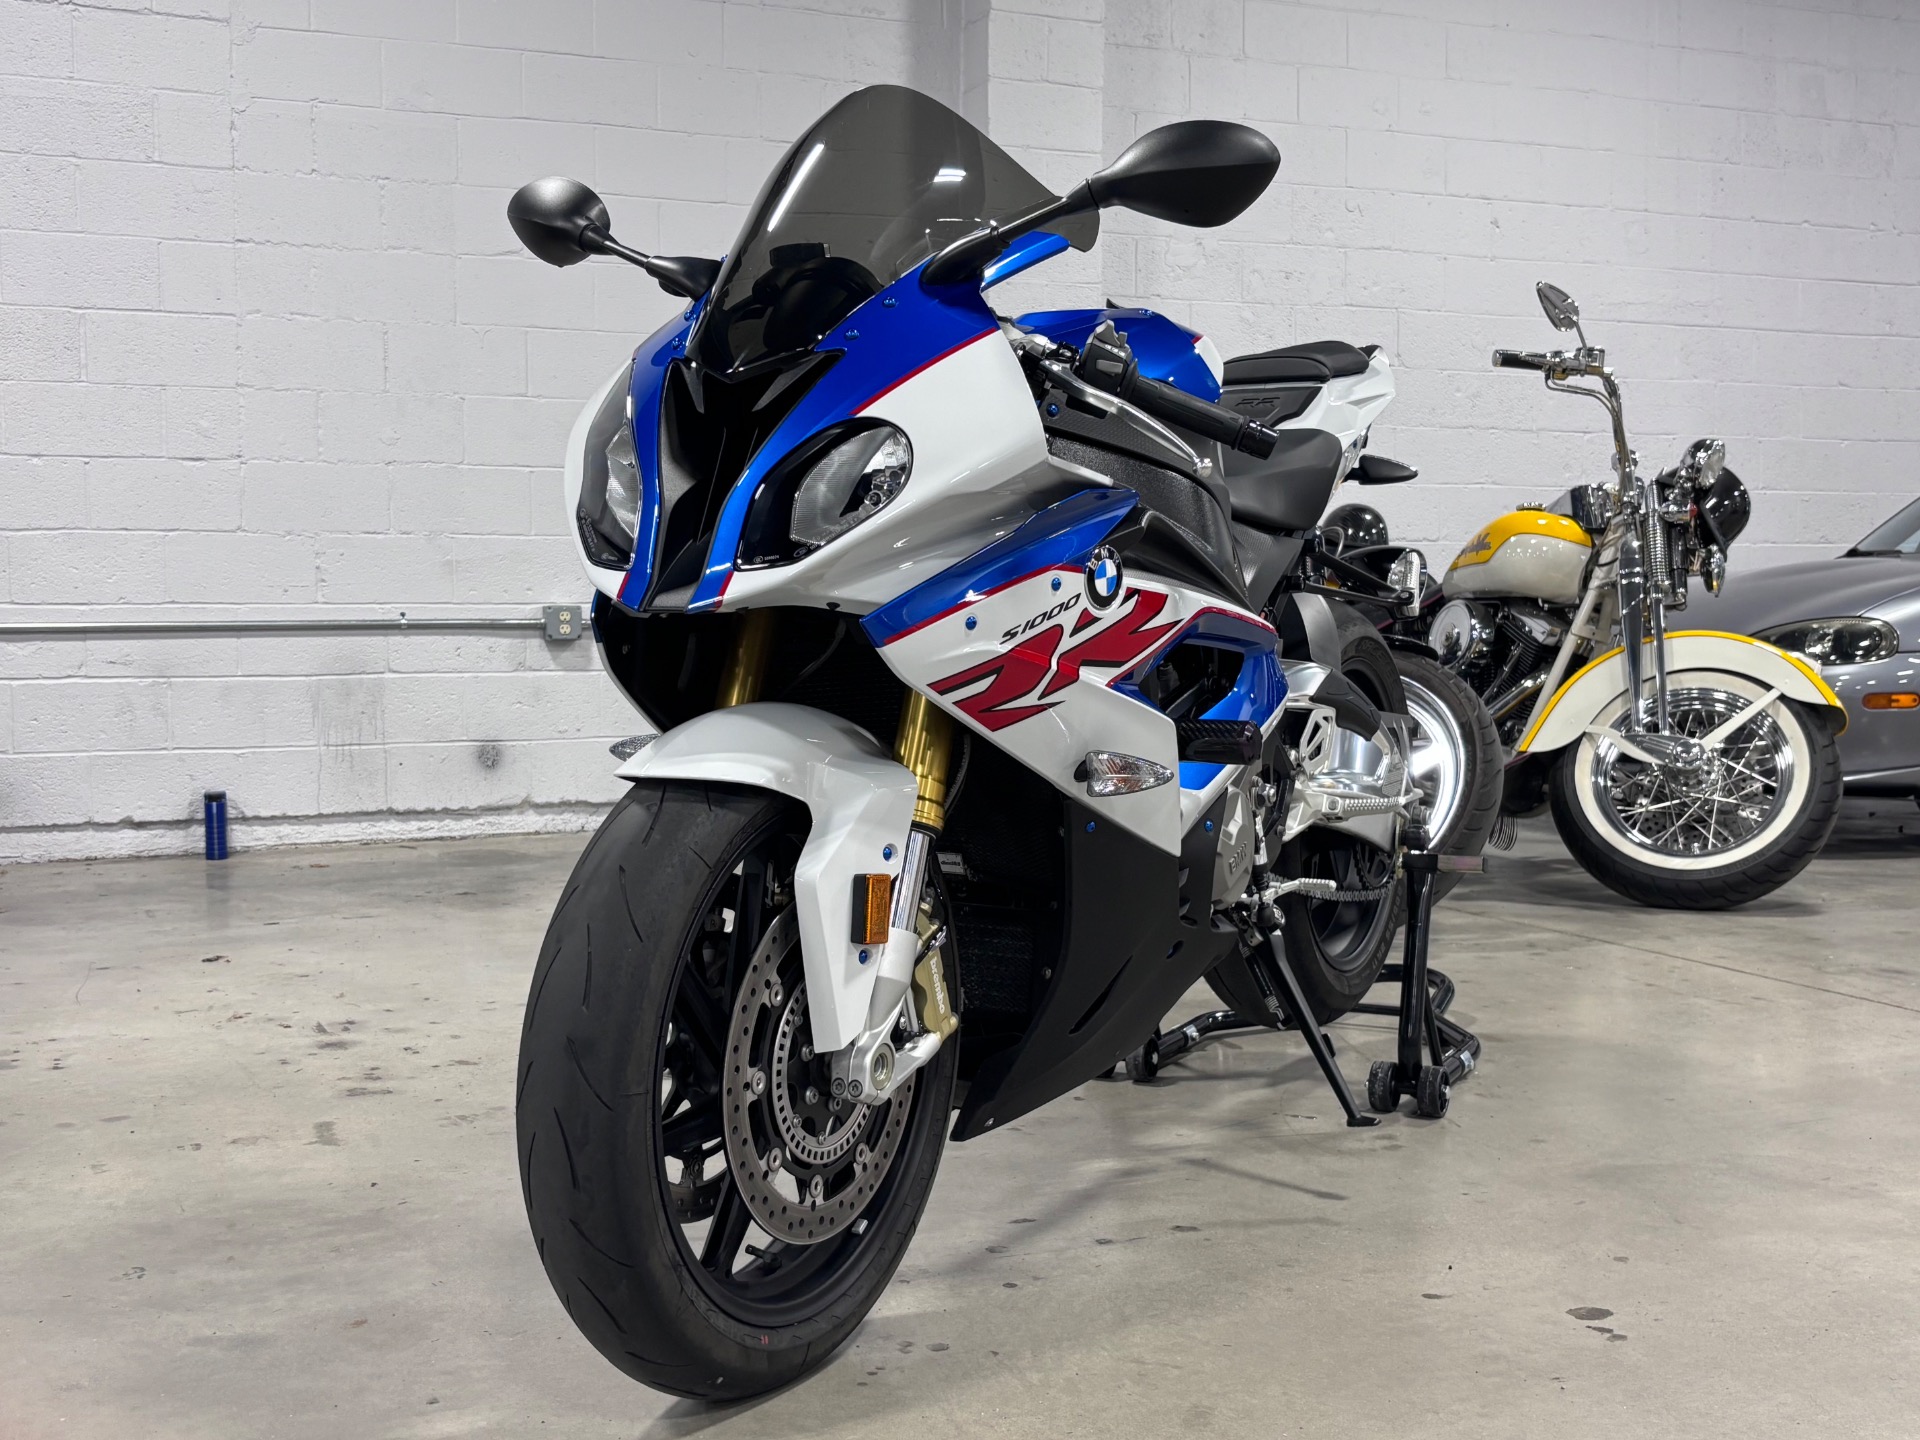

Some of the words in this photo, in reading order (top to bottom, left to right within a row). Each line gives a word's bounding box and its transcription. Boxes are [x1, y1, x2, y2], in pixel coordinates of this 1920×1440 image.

[1090, 547, 1120, 571] BMW
[1000, 592, 1082, 645] S1000
[1228, 840, 1248, 875] BMW
[929, 956, 946, 1015] brembo
